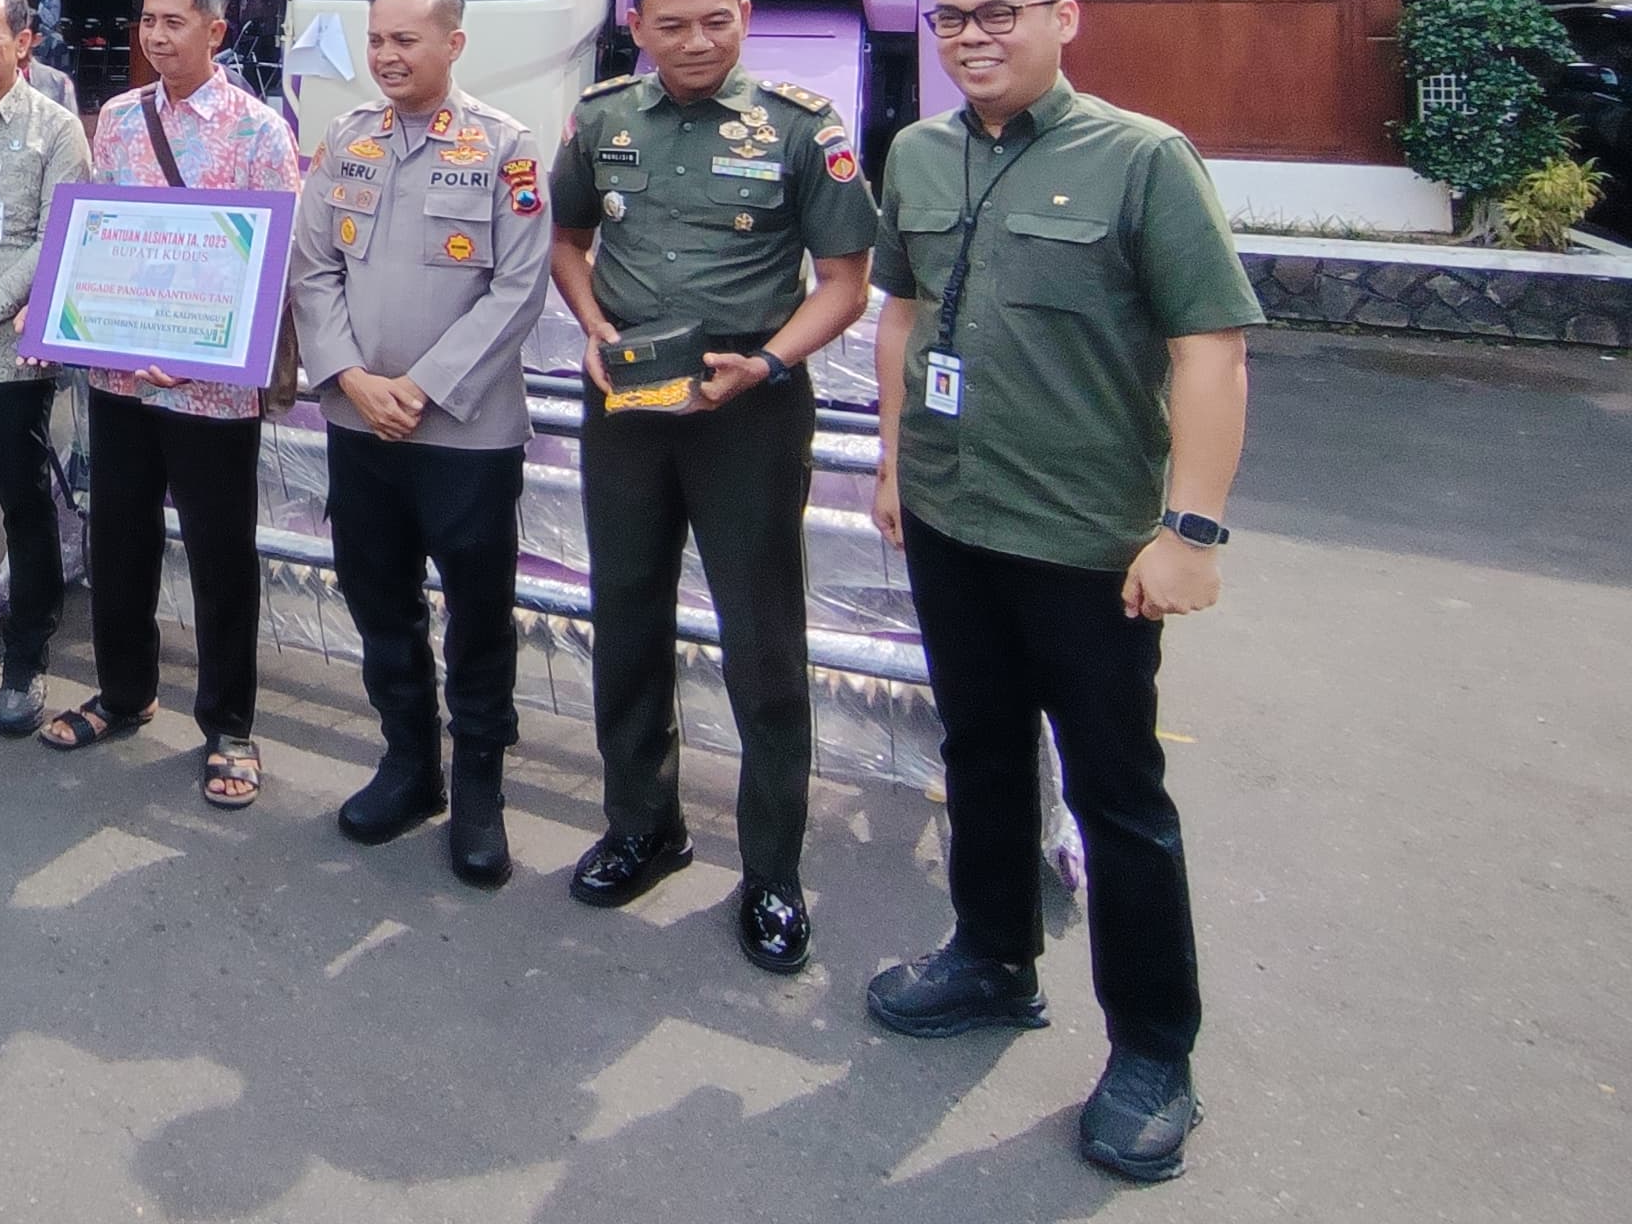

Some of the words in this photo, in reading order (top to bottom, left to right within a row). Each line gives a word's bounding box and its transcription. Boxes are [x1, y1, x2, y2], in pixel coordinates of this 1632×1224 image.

[341, 161, 376, 180] HERU
[431, 172, 489, 187] POLRI
[101, 228, 140, 242] BANTUAN
[142, 230, 185, 246] ALSINTAN
[202, 234, 228, 248] 2025
[112, 246, 159, 260] BUPATI
[162, 249, 209, 263] KUDUS
[75, 281, 115, 294] BRIGADE
[117, 285, 157, 298] PANGAN
[158, 289, 207, 302] KANTONG
[208, 294, 233, 305] TANI
